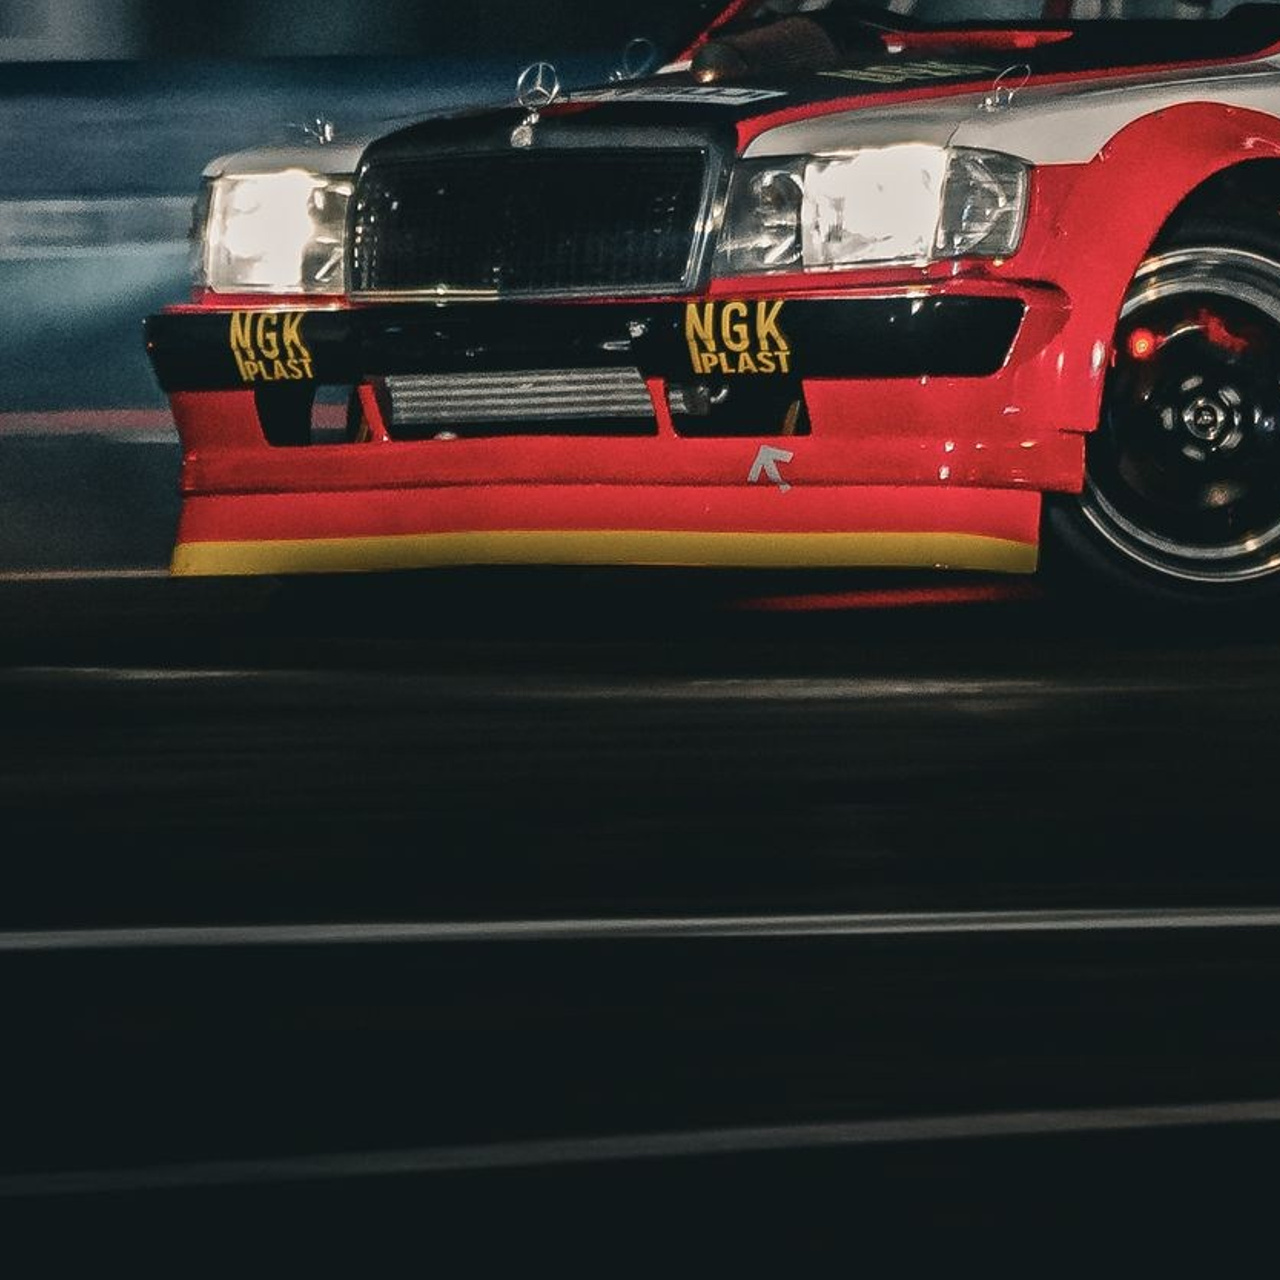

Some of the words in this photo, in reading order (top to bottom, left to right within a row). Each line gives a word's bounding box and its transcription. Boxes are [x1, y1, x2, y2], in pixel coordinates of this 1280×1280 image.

[230, 310, 310, 380] NGK
[685, 300, 789, 373] NGK
[243, 358, 314, 381] PLAST
[701, 351, 791, 374] PLAST
